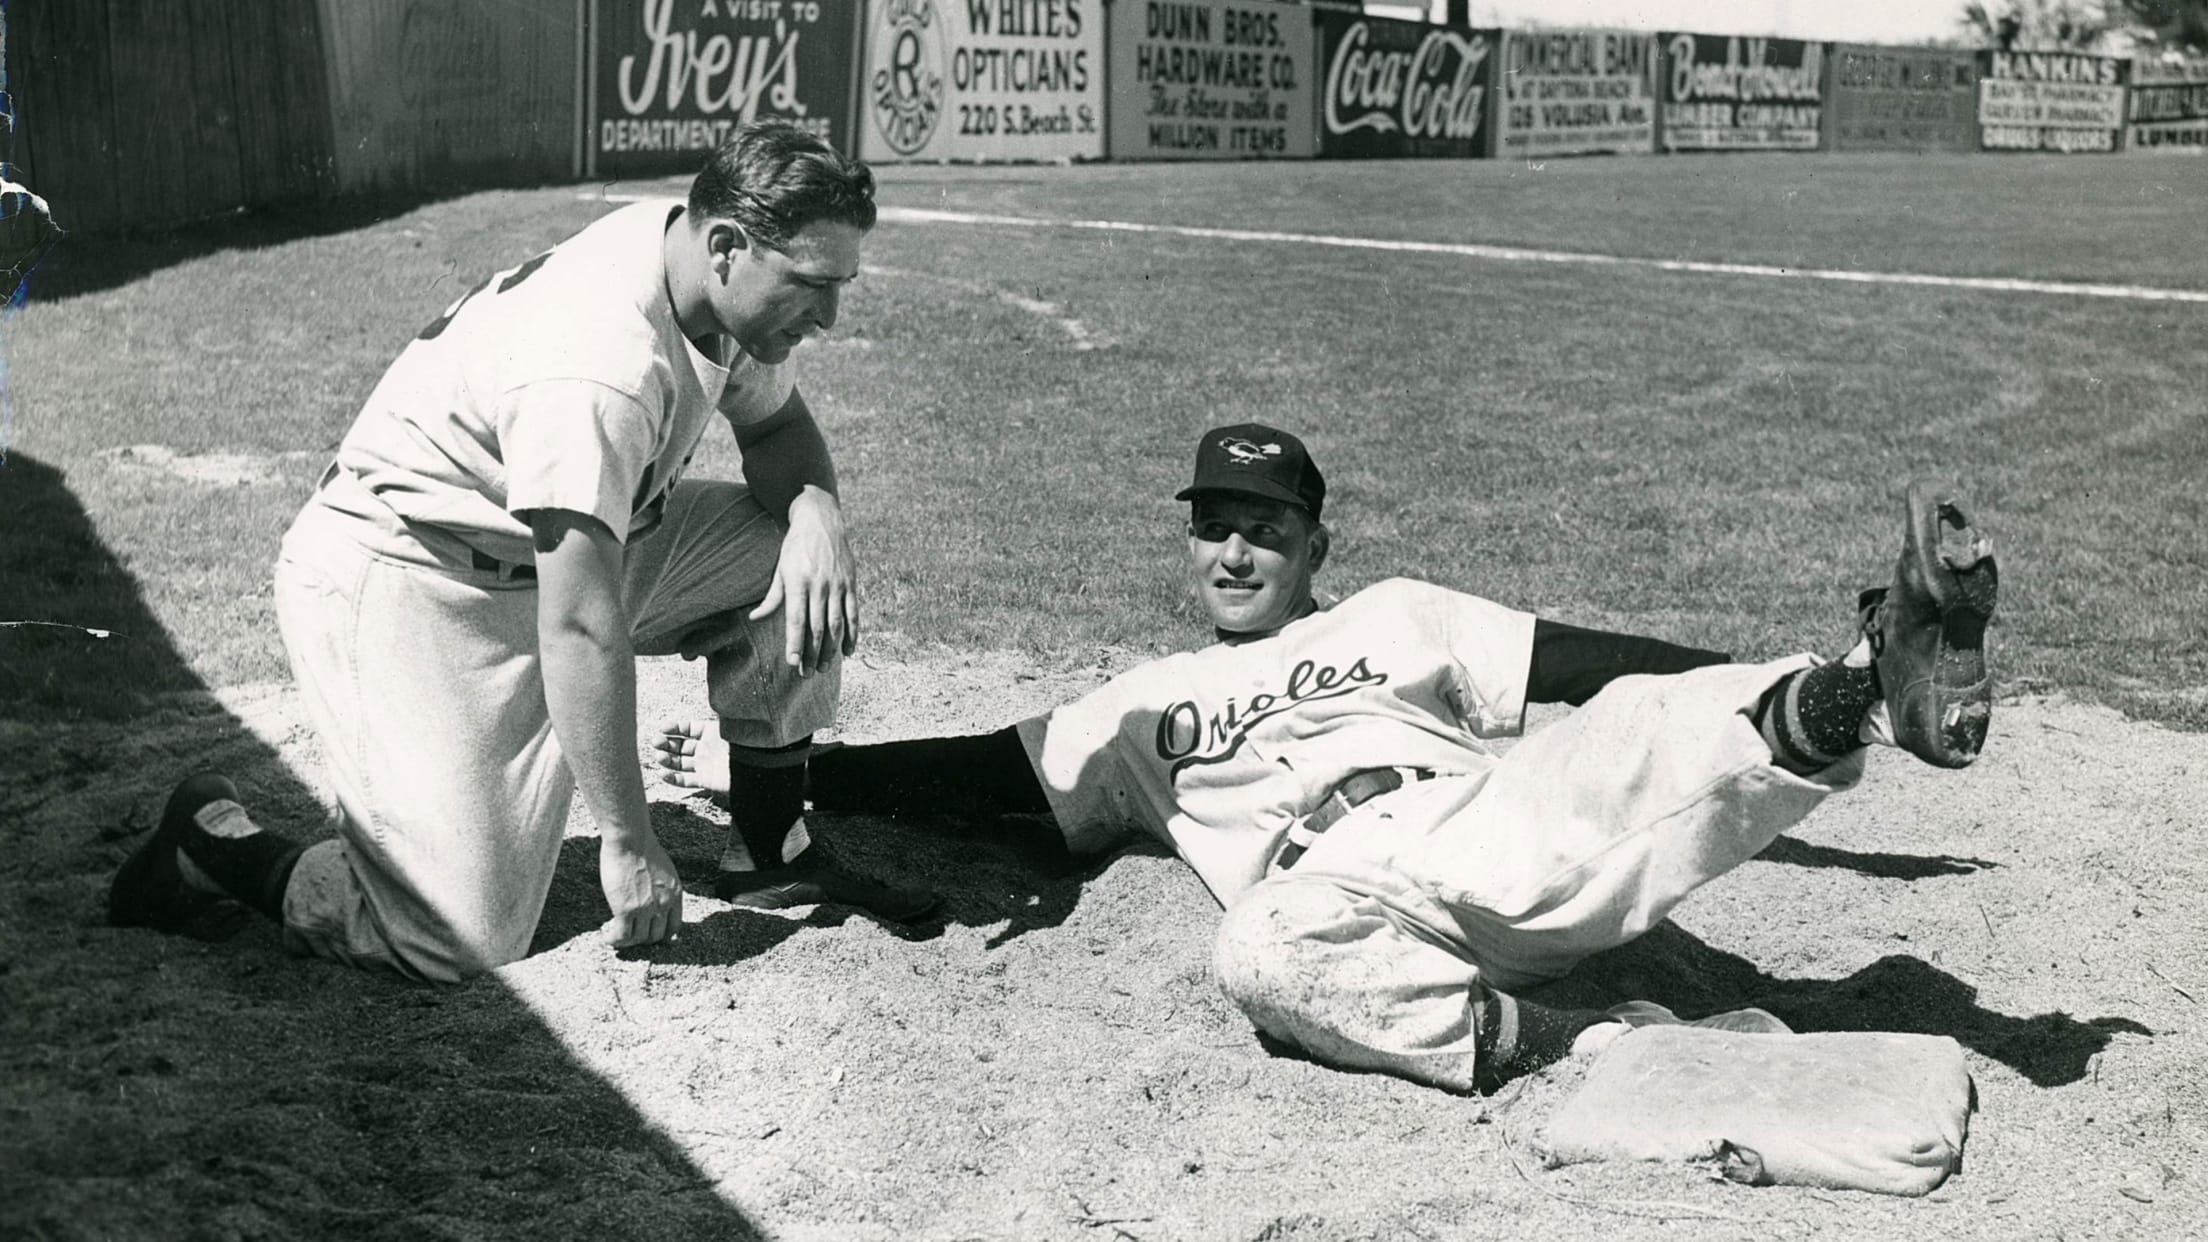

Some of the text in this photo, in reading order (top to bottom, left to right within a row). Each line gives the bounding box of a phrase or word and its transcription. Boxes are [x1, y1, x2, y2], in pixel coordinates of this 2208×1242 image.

[700, 0, 821, 22] A VISIT TO
[1147, 2, 1286, 48] DUNN BROS.
[953, 46, 1088, 92] OPTICIANS
[1136, 44, 1297, 90] HARDWARE CO.
[1993, 51, 2116, 84] HANKINS
[601, 118, 733, 151] DEPARTMENT
[960, 104, 998, 135] 220
[1148, 124, 1287, 151] MILLION ITEMS
[1156, 656, 1388, 775] Orioles
